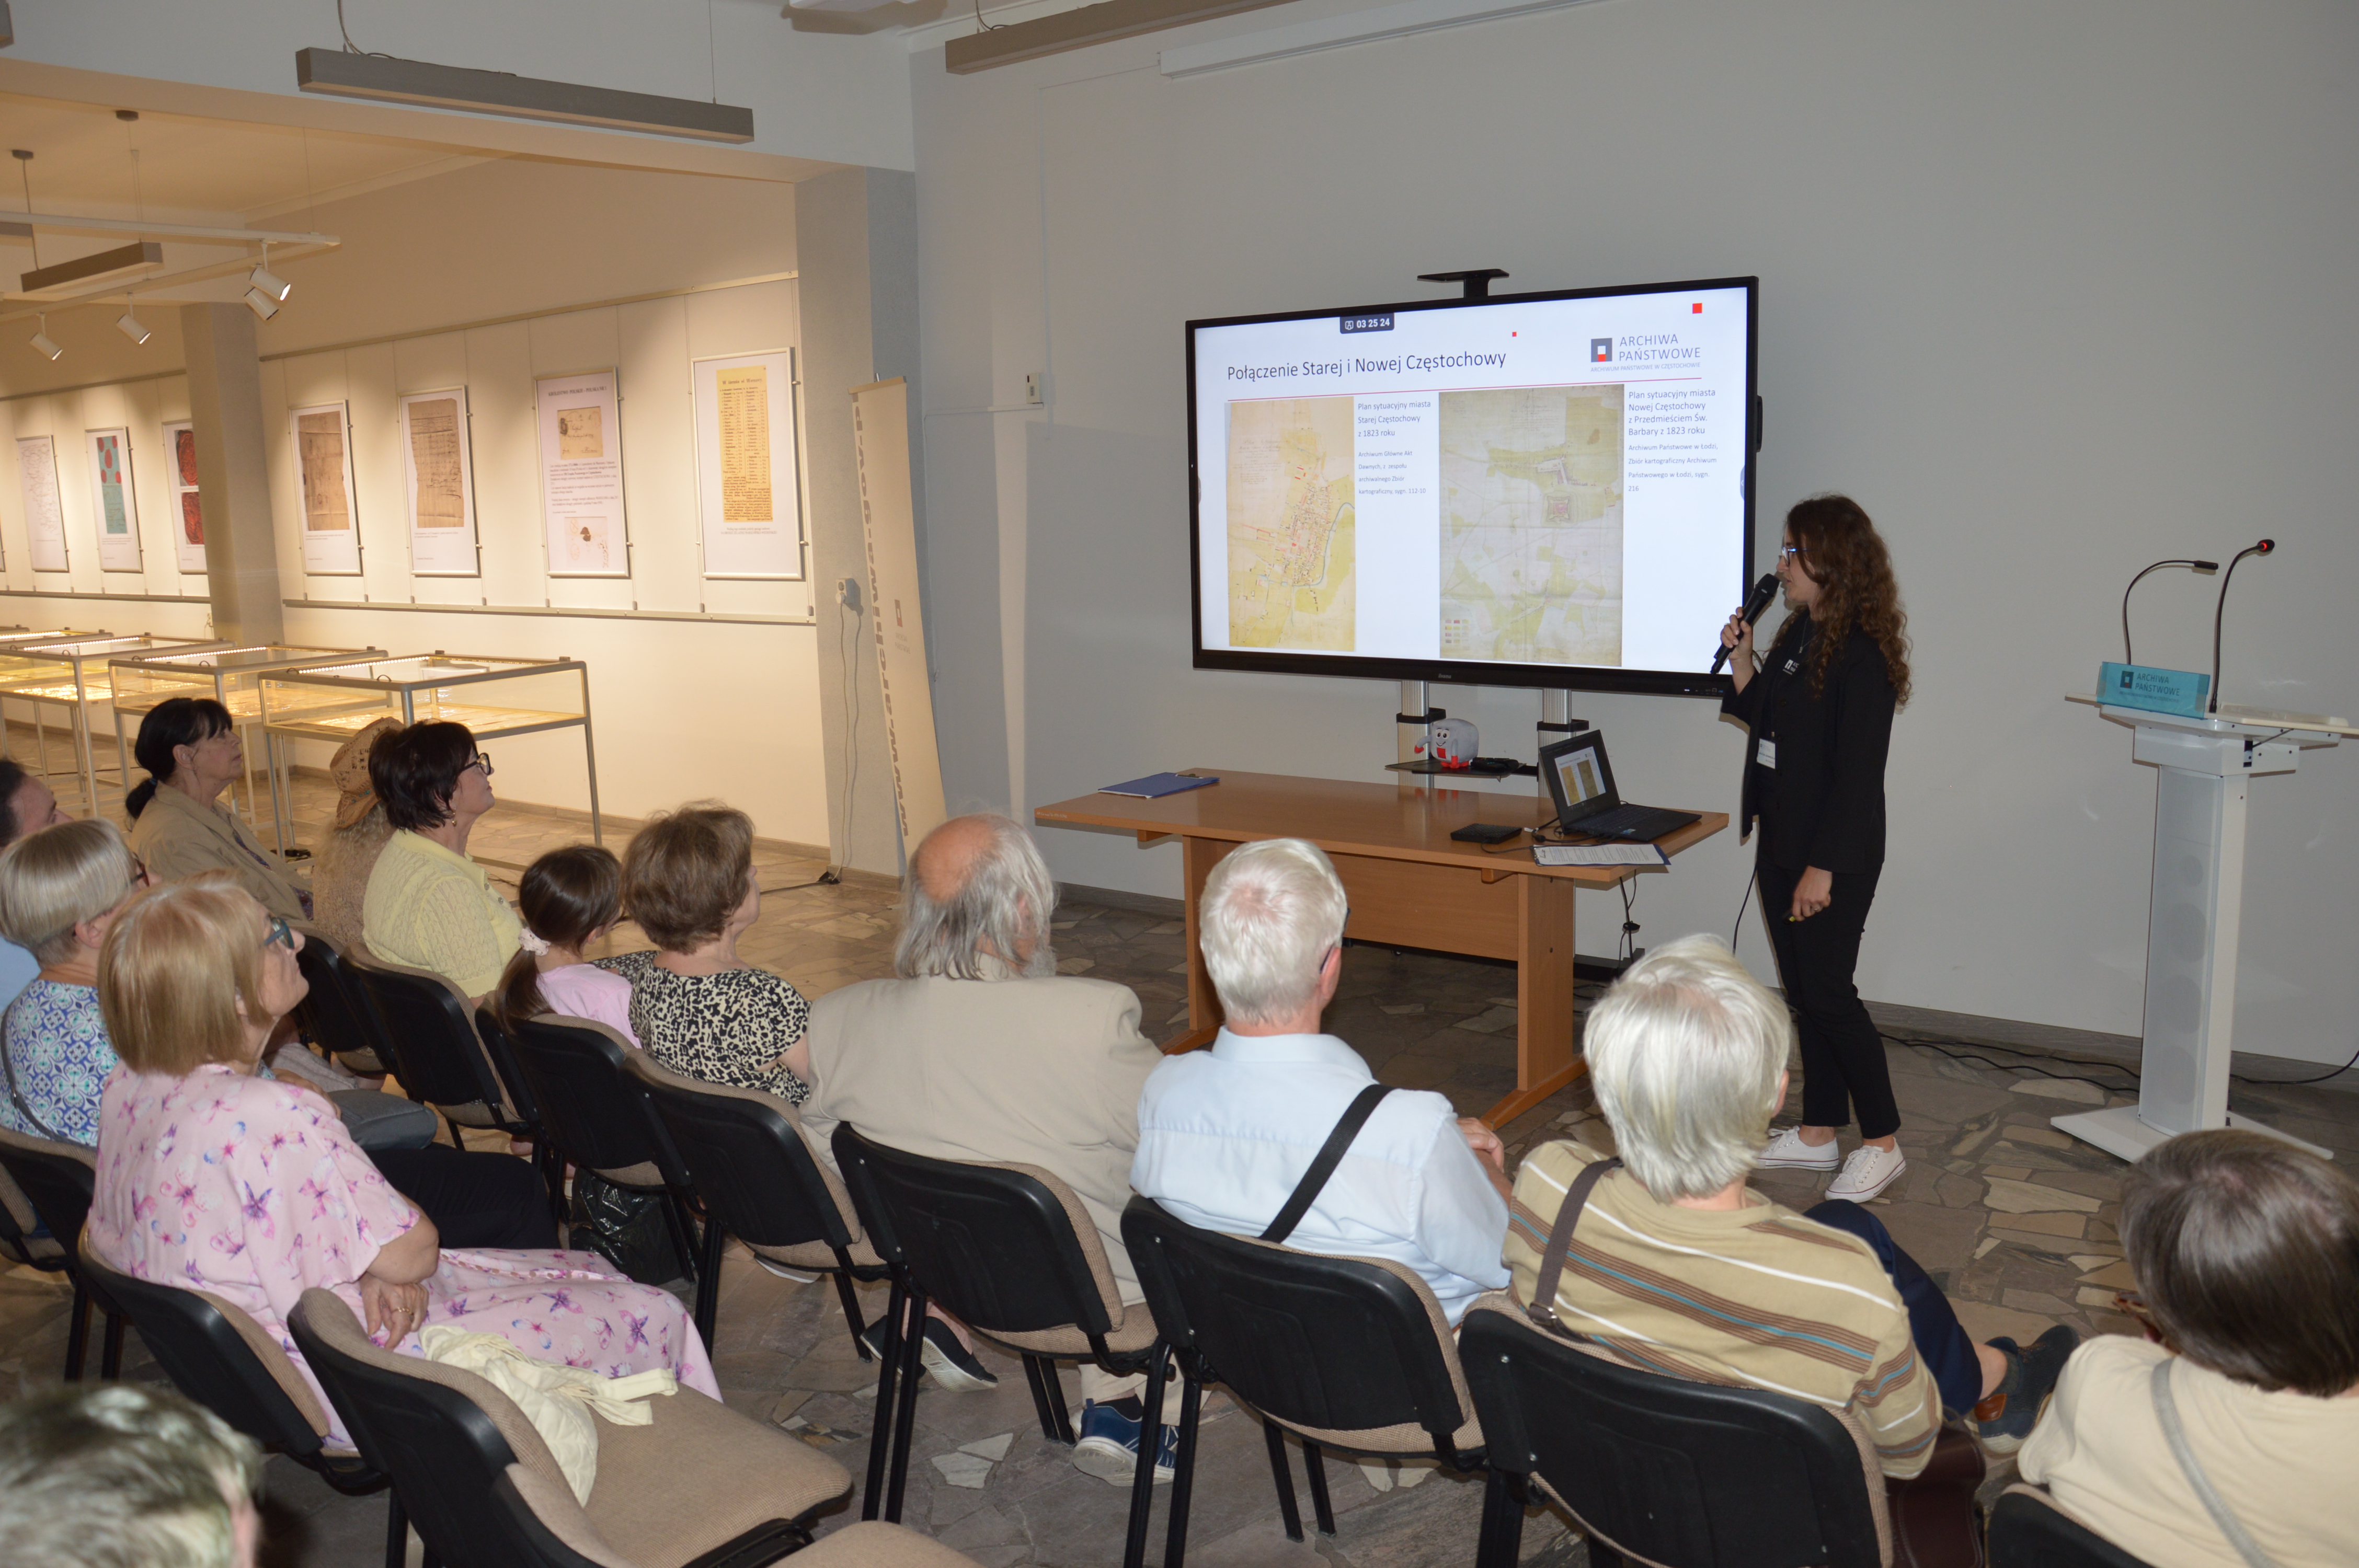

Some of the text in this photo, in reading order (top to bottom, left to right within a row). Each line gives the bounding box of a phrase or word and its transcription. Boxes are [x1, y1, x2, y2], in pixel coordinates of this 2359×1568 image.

[1356, 318, 1390, 328] 03 25 24
[1620, 334, 1678, 347] ARCHIWA
[1619, 348, 1701, 361] PAŃSTWOWE
[1228, 351, 1506, 382] Połączenie Starej i Nowej Częstochowy
[1647, 390, 1688, 400] sytuacyjny
[1373, 401, 1407, 411] sytuacyjny
[1629, 402, 1706, 412] Nowej Częstochowy
[1358, 415, 1421, 424] Starej Częstochowy
[1634, 414, 1692, 423] Przedmieściem
[1694, 412, 1708, 421] Św.
[1629, 428, 1658, 436] Barbary
[852, 393, 909, 837] www.archiwa.gov.pl
[2137, 673, 2169, 684] ARCHIWA
[2135, 682, 2181, 696] PAŃSTWOWE
